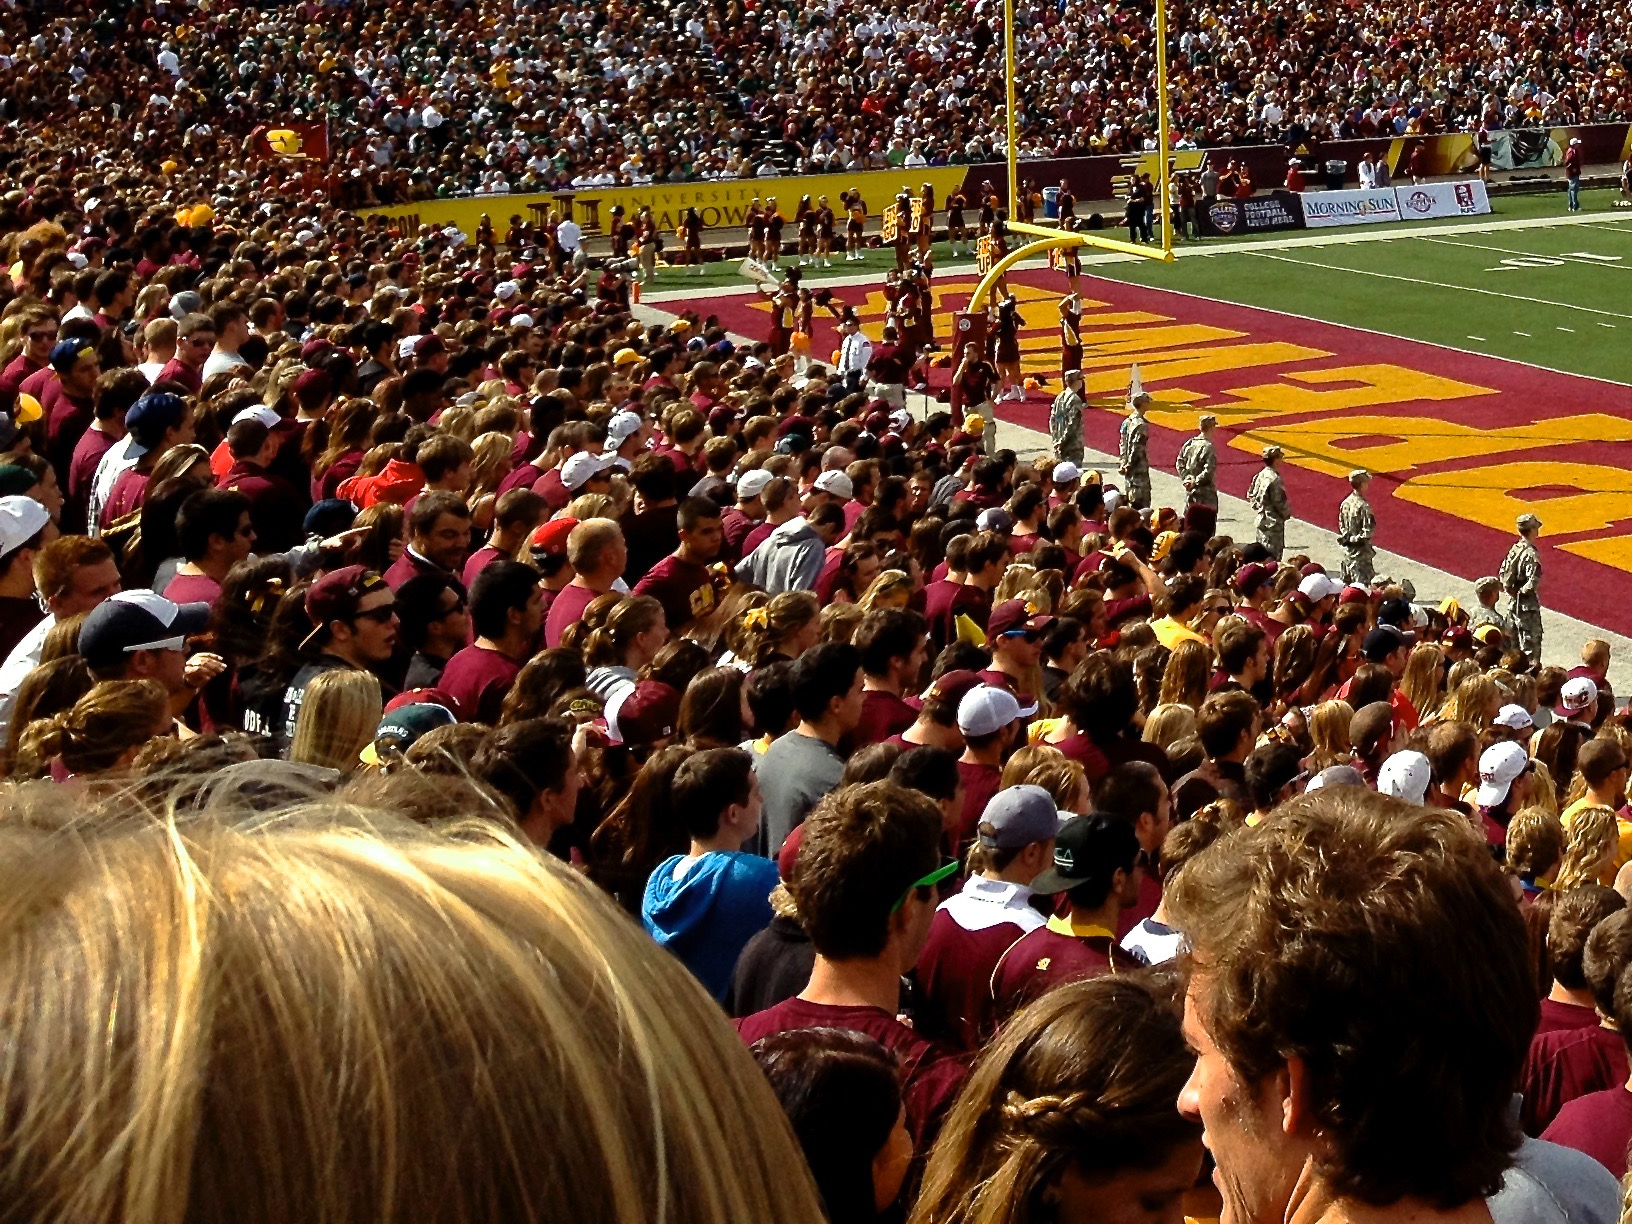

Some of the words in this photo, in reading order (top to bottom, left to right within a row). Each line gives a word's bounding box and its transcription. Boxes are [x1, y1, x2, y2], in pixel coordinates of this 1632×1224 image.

[612, 187, 762, 208] UNIVERSITY
[1243, 199, 1281, 211] COLLEGE
[1306, 200, 1368, 216] MORNING
[1368, 197, 1394, 210] SUN
[1460, 206, 1477, 214] KFC
[1245, 207, 1288, 219] FOOTBALL
